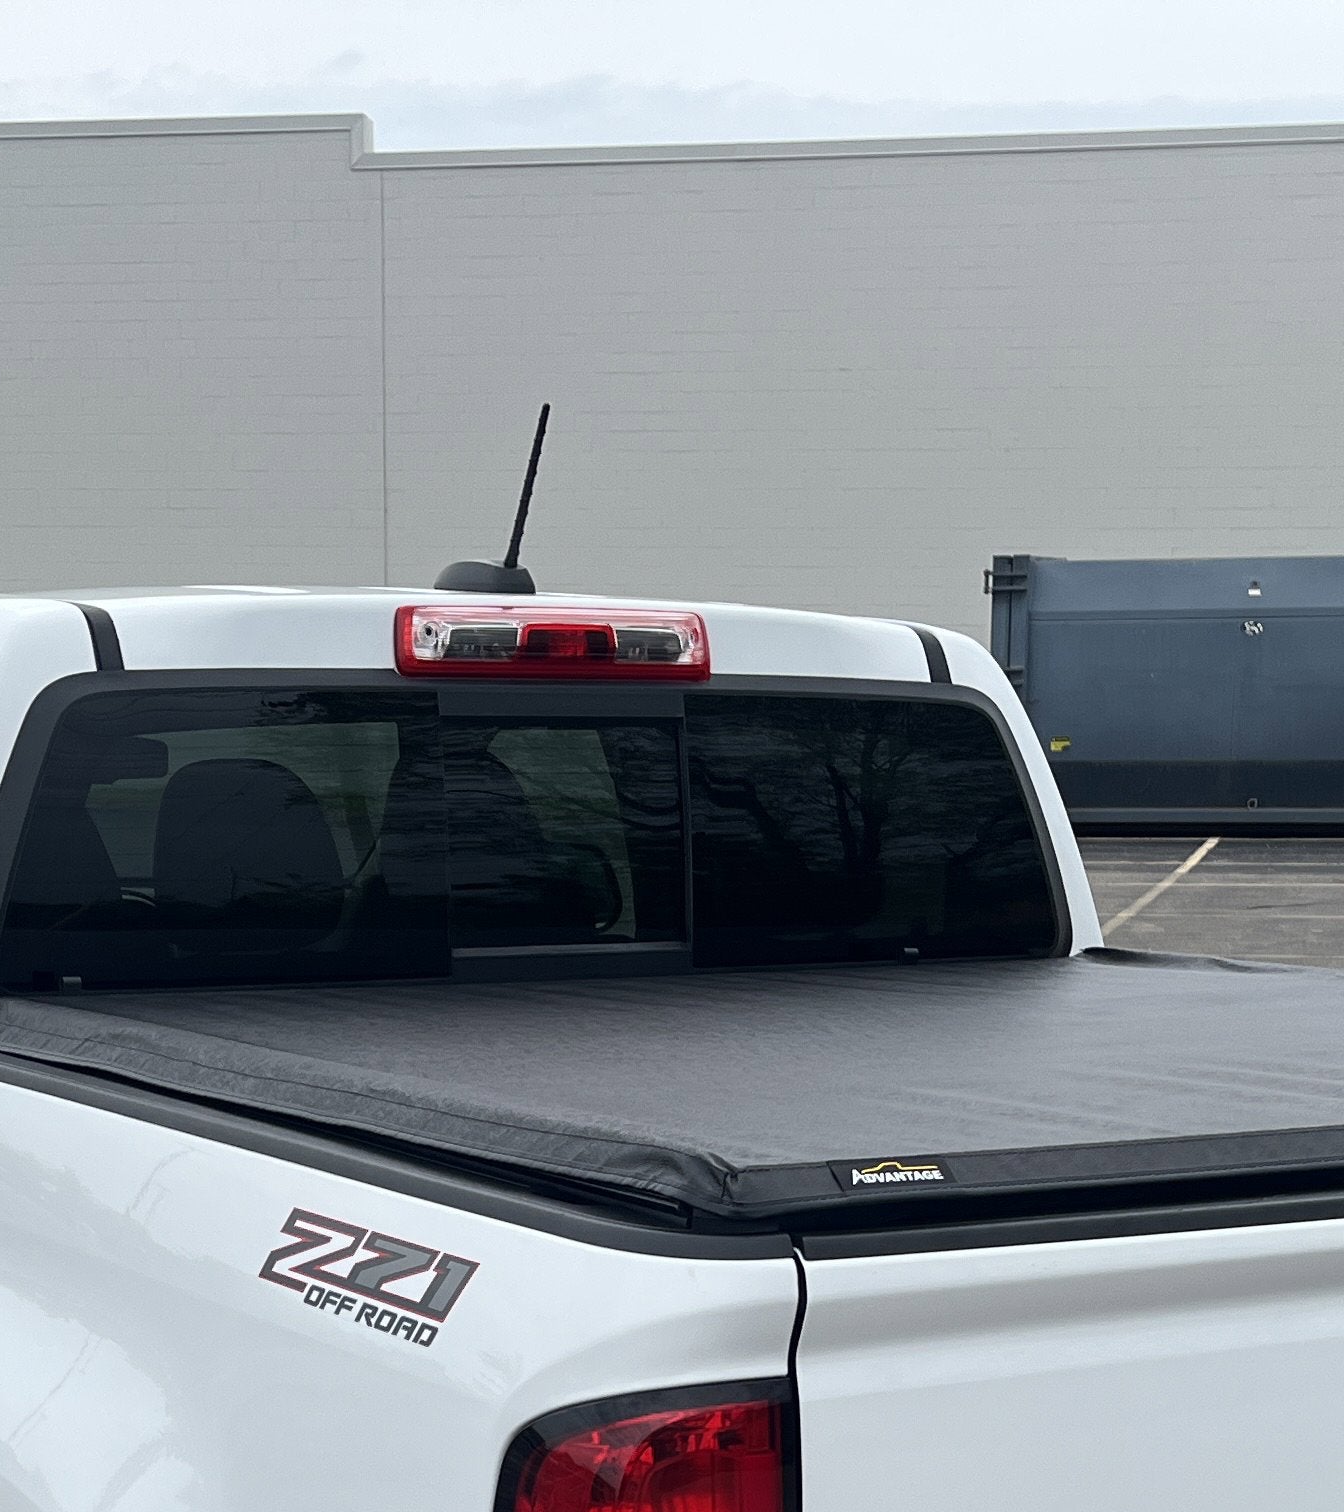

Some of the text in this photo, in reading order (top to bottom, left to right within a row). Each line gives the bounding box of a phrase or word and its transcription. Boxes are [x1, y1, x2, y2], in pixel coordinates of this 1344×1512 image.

[851, 1168, 945, 1186] ADVANTAGE
[258, 1206, 481, 1324] Z71
[303, 1284, 440, 1347] OFF ROAD
